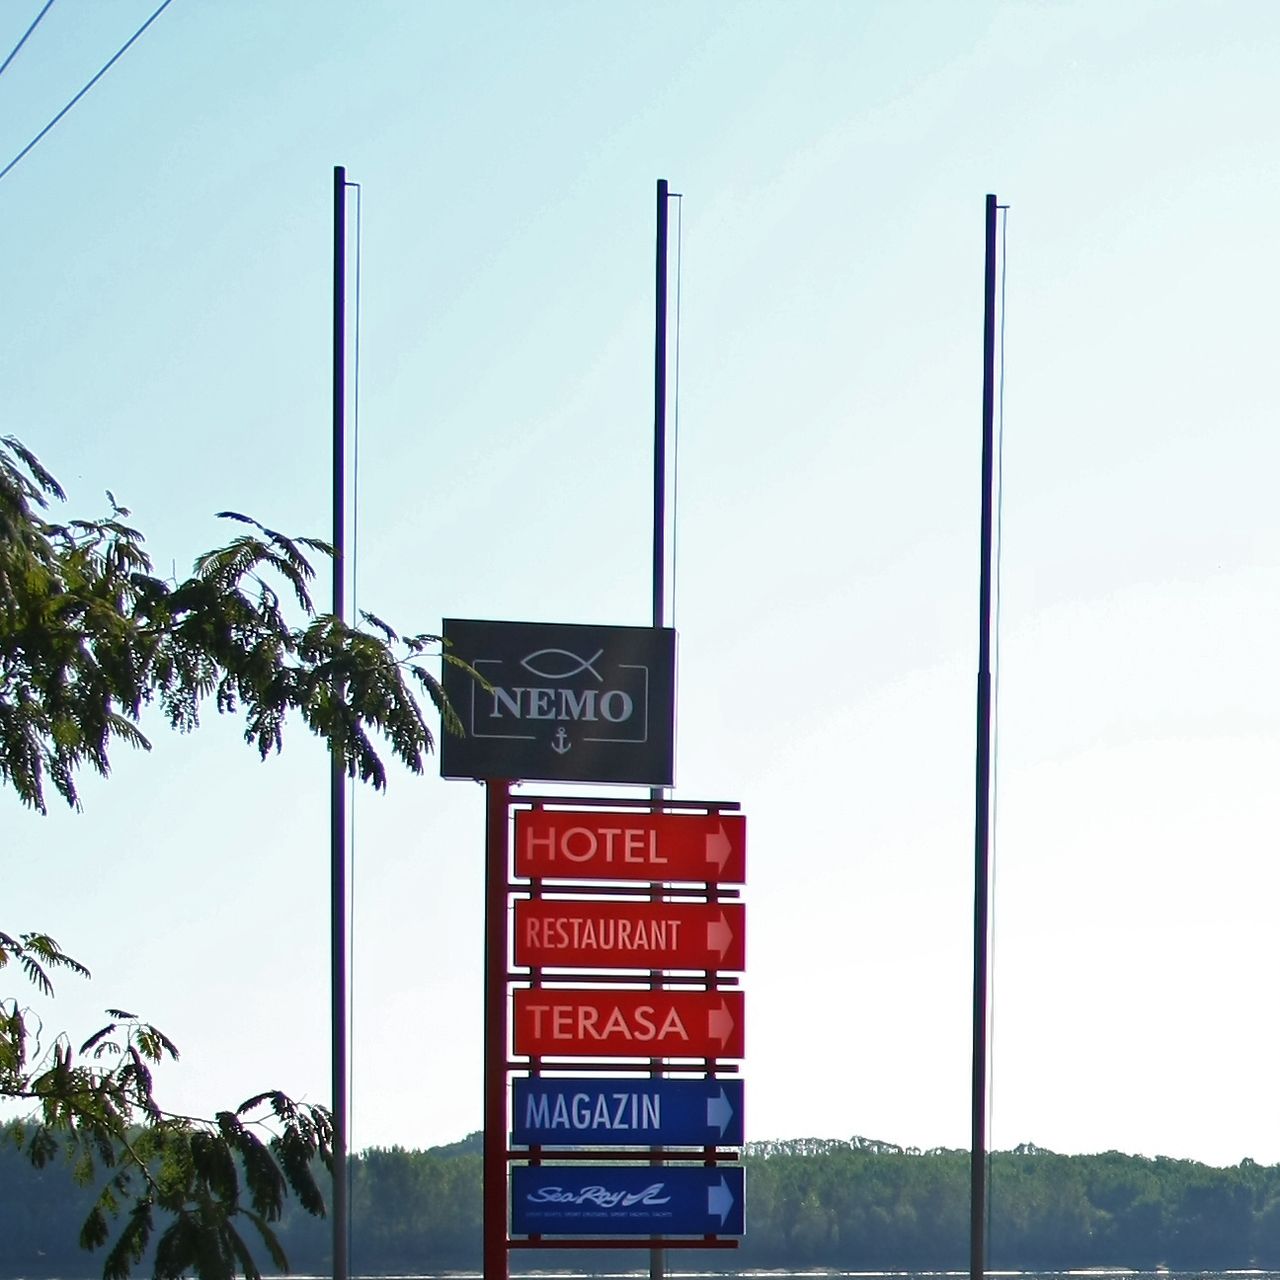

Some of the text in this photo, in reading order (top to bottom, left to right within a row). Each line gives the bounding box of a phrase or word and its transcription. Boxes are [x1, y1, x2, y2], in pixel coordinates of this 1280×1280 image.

[489, 686, 634, 723] NEMO
[526, 827, 668, 865] HOTEL
[526, 917, 682, 951] RESTAURANT
[525, 1005, 689, 1041] TERASA
[525, 1092, 661, 1130] MAGAZIN
